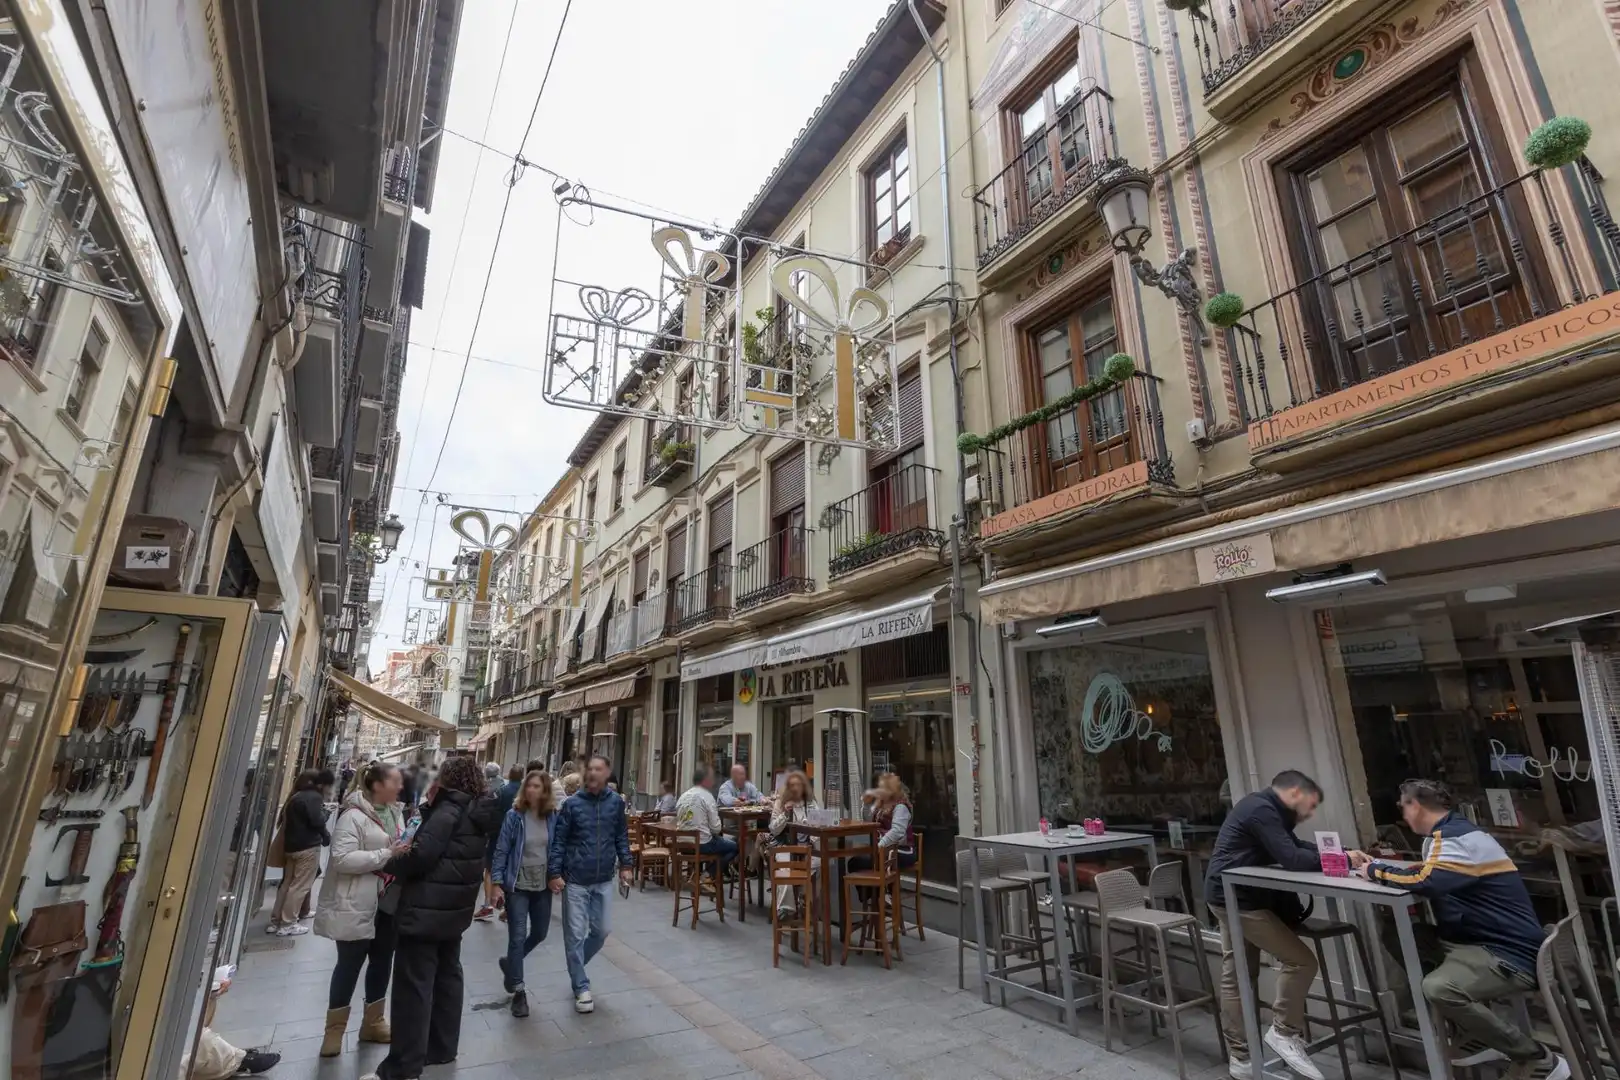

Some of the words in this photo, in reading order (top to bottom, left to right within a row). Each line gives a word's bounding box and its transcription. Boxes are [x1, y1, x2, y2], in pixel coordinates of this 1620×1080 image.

[206, 1, 232, 130] Distribuidor
[1283, 363, 1451, 433] APARTAMENTOS
[998, 507, 1036, 530] CASA
[1053, 467, 1142, 510] CATEDRAL
[1215, 548, 1249, 570] ROLLO
[861, 625, 874, 639] LA
[878, 612, 923, 635] RIFFEÑA
